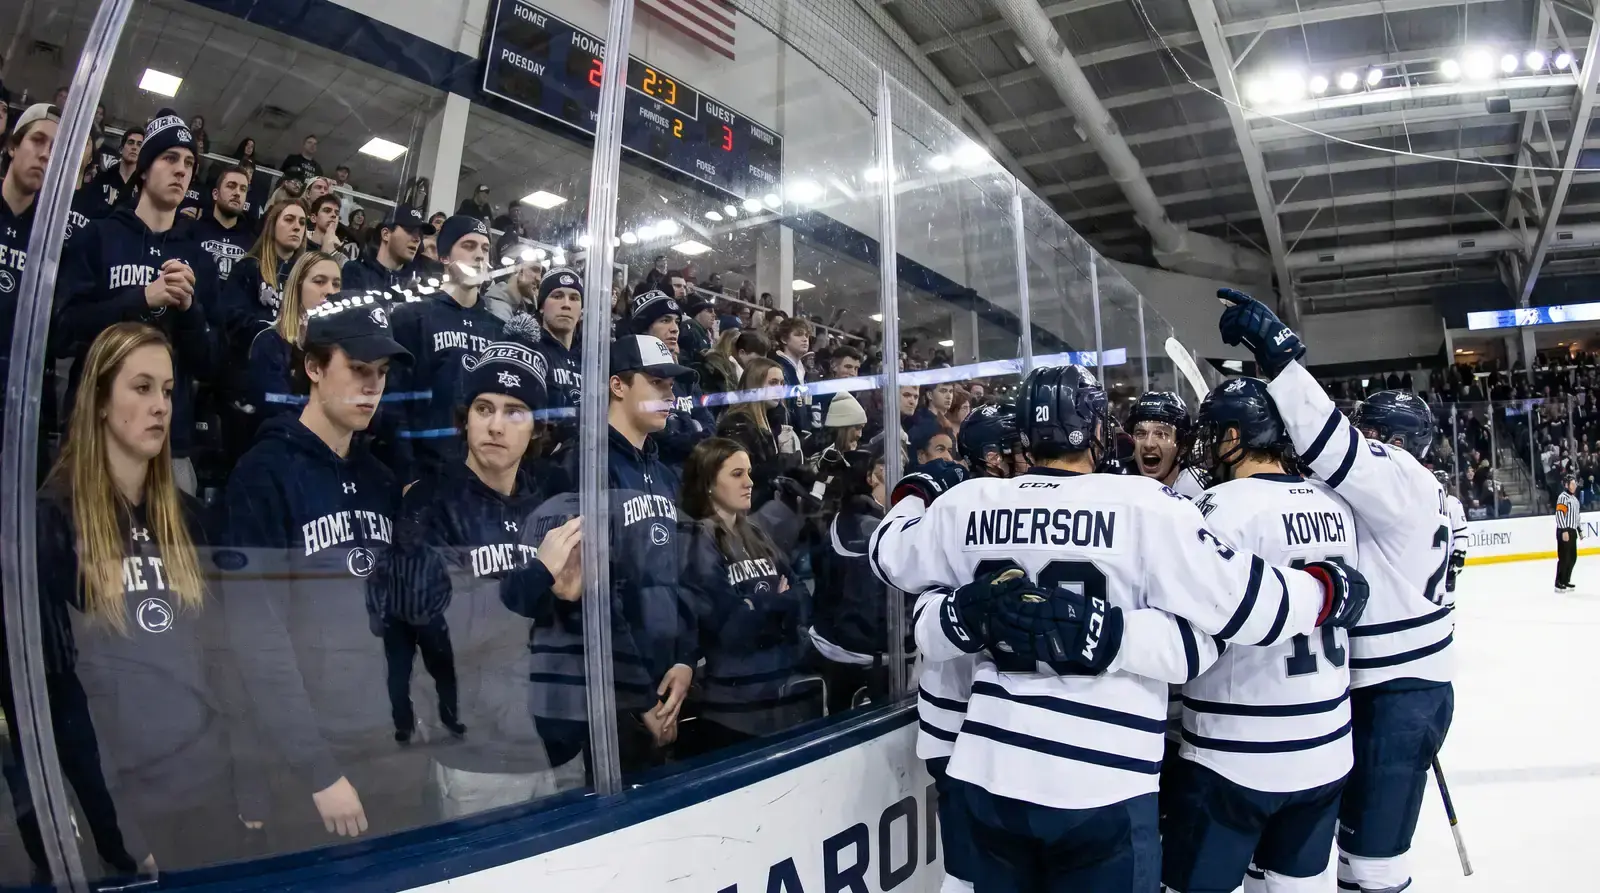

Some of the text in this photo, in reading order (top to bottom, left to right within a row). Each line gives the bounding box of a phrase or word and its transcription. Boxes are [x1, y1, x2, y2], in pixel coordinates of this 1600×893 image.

[571, 31, 606, 60] HOME
[588, 58, 605, 88] 2
[705, 101, 736, 126] GUEST
[673, 118, 683, 138] 2
[721, 125, 733, 152] 3
[109, 264, 155, 290] HOME
[433, 330, 469, 353] HOME
[1035, 405, 1050, 422] 20
[1018, 481, 1061, 489] CCM
[622, 494, 656, 527] HOME
[302, 510, 355, 557] HOME
[965, 507, 1117, 549] ANDERSON
[1281, 511, 1347, 546] KOVICH
[1081, 596, 1105, 662] CCM
